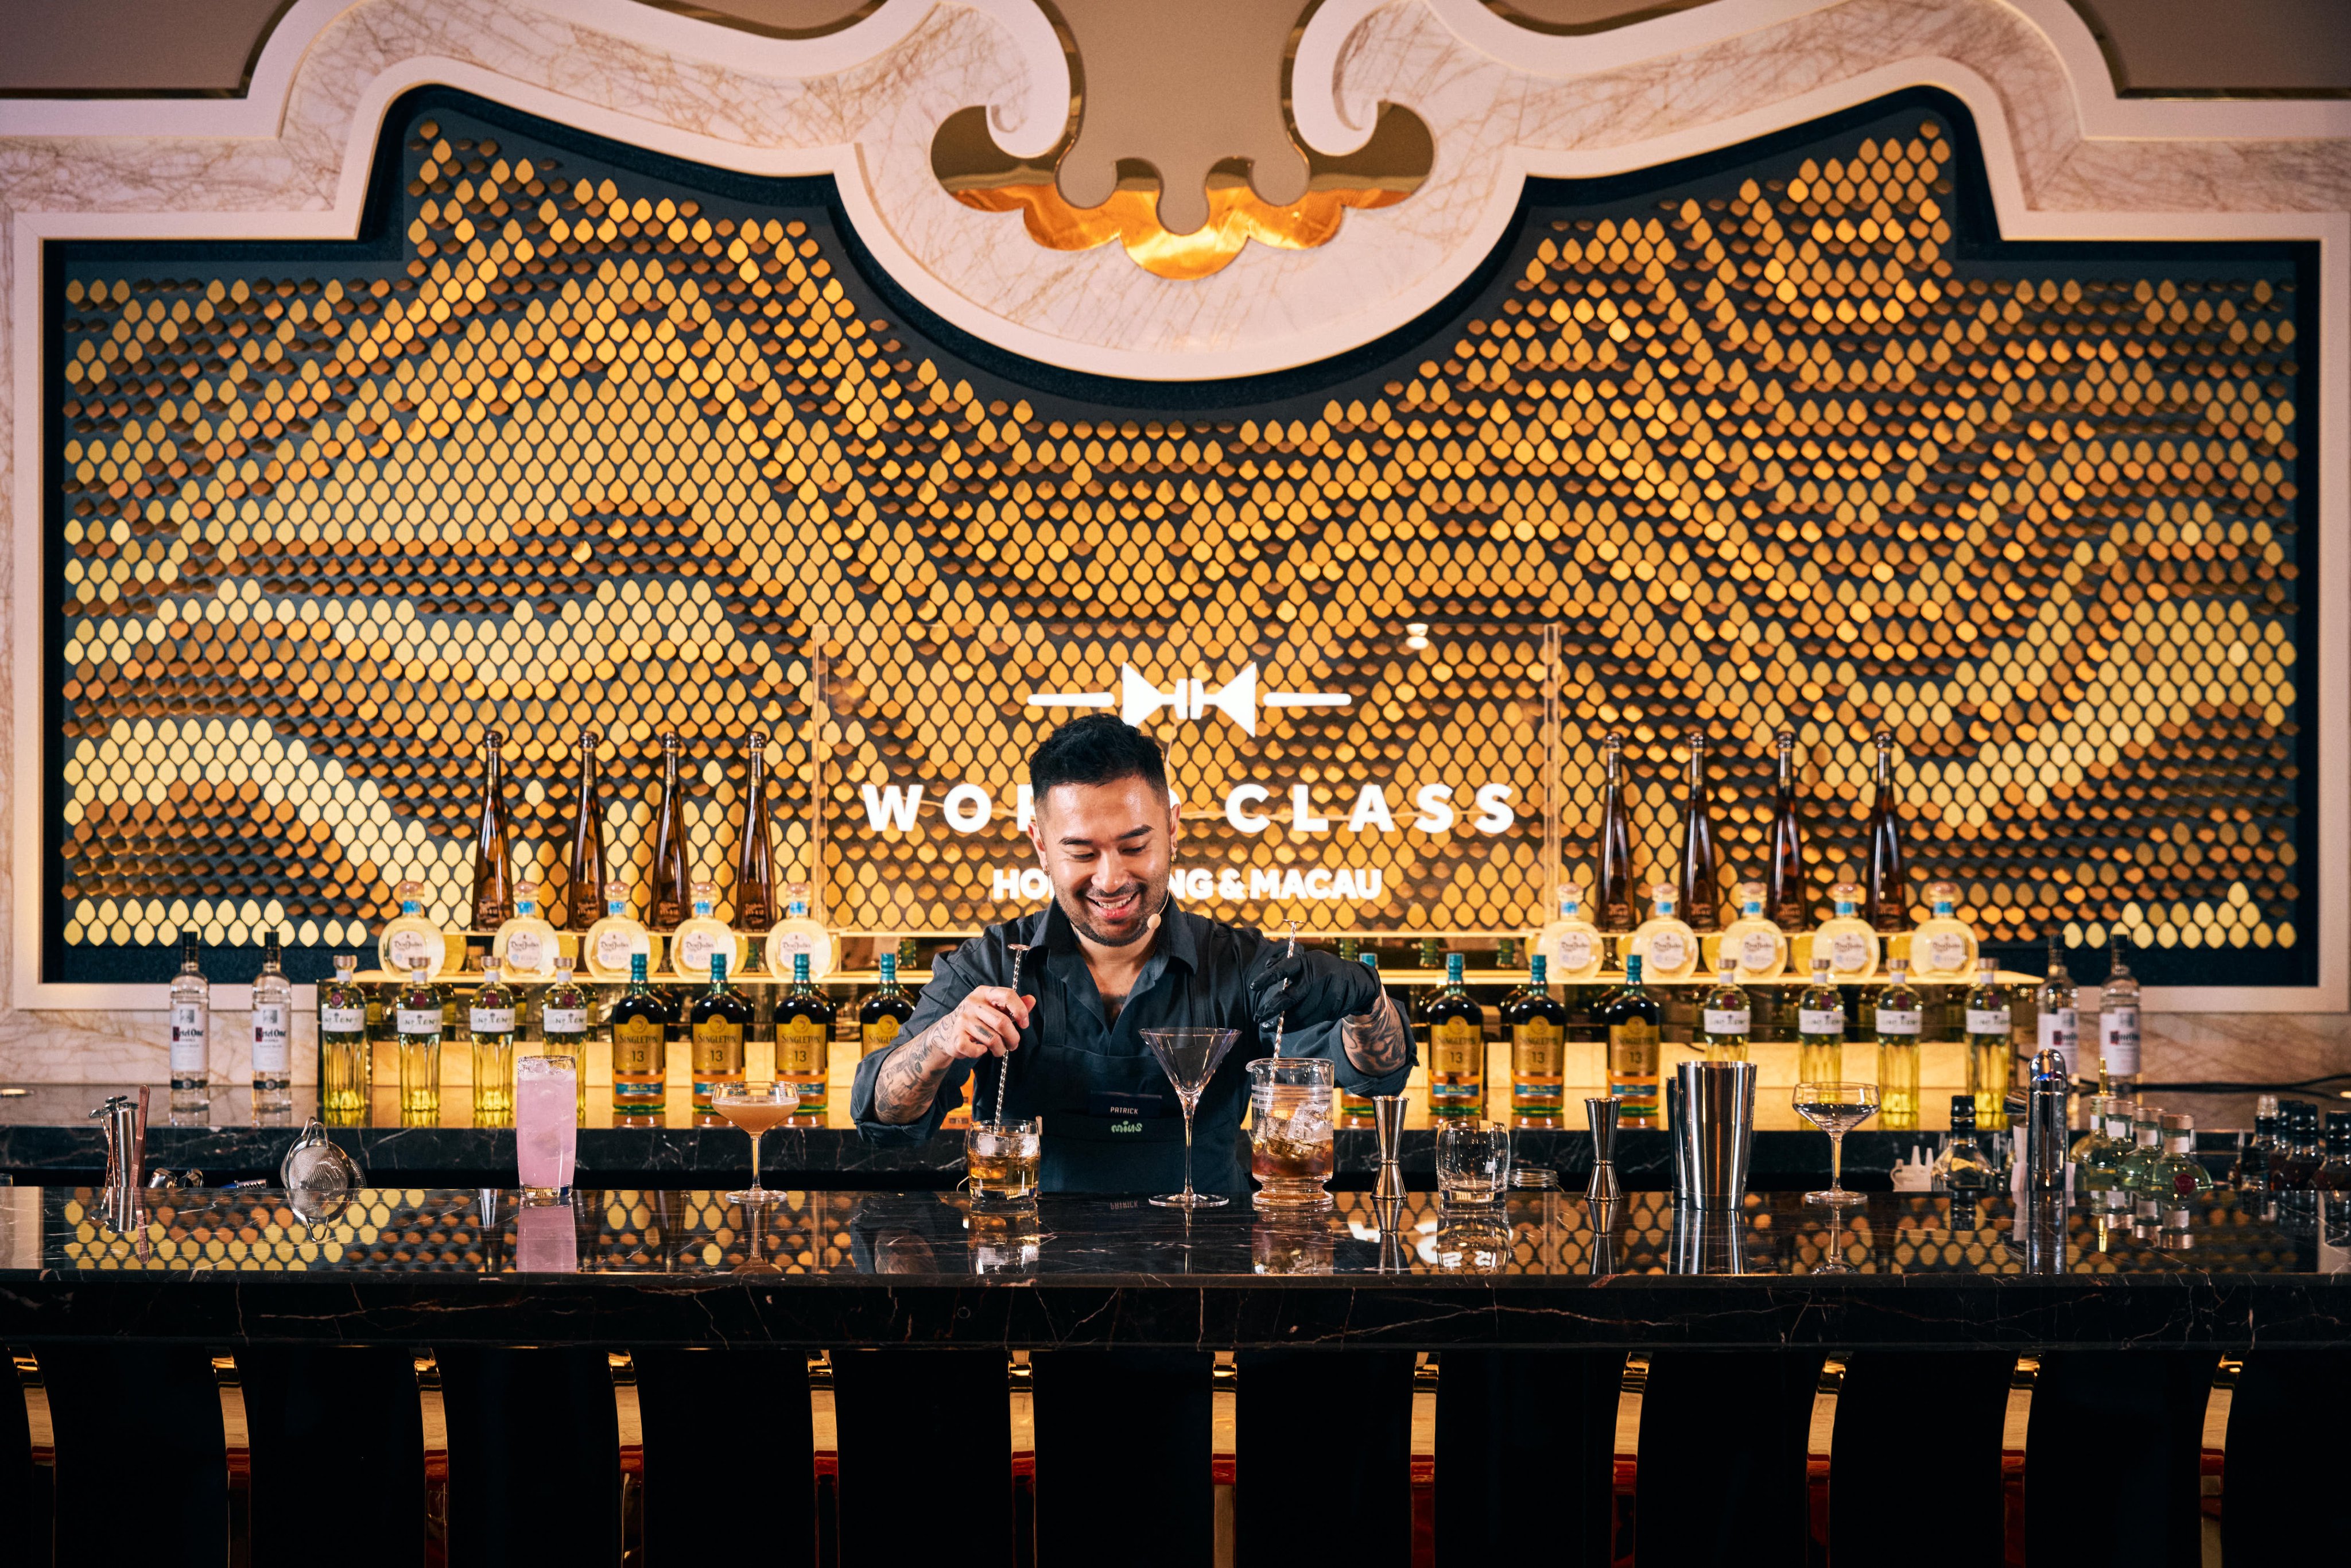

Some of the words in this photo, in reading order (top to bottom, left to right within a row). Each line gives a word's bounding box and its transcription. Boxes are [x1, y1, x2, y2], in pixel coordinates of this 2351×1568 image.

[1225, 783, 1514, 833] CLASS
[993, 868, 1056, 899] HO
[1169, 868, 1213, 900] NG
[1250, 868, 1382, 899] MACAU
[619, 1035, 658, 1043] SINGLETON
[698, 1034, 737, 1043] SINGLETON
[782, 1034, 820, 1043] SINGLETON
[633, 1051, 644, 1062] 13
[711, 1050, 723, 1062] 13
[794, 1051, 806, 1062] 13
[1450, 1051, 1463, 1063] 13
[1532, 1051, 1545, 1064] 13
[1630, 1051, 1642, 1064] 13
[1110, 1107, 1138, 1115] PATRICK
[1111, 1120, 1143, 1133] mius
